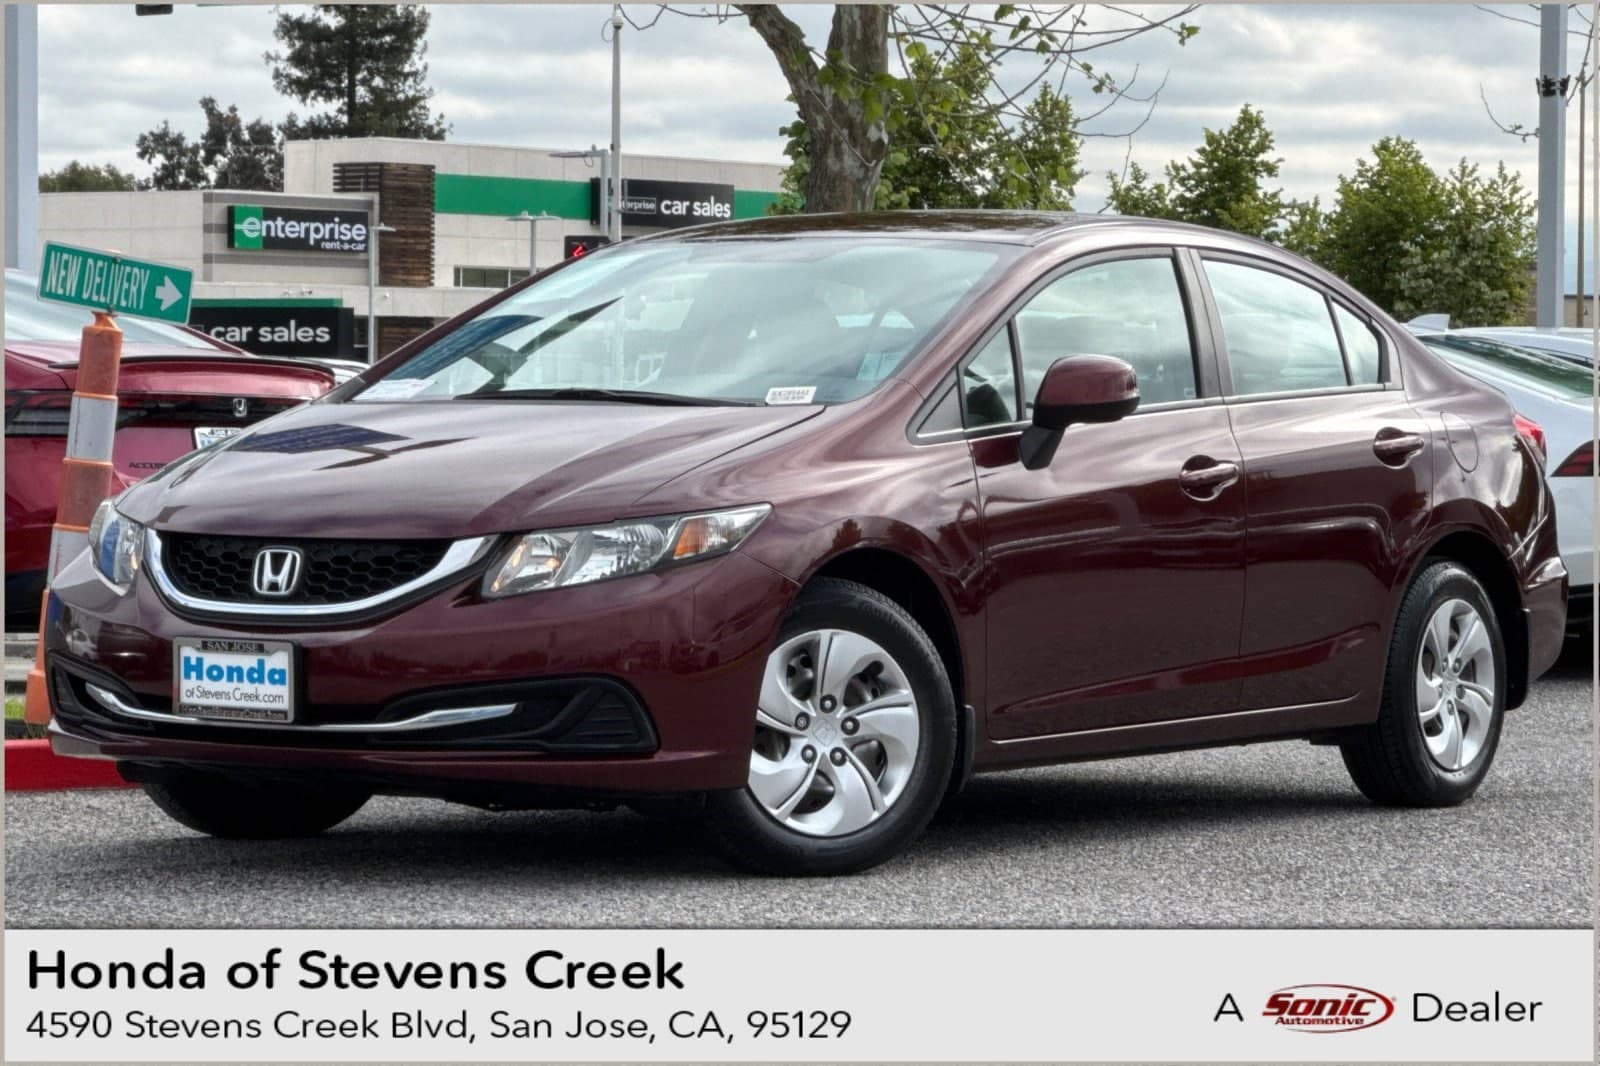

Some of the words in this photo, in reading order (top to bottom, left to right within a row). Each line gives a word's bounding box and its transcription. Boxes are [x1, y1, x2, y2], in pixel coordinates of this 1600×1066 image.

[619, 200, 656, 210] terprise
[660, 199, 690, 215] car
[692, 196, 731, 217] sales
[236, 216, 367, 246] enterprise
[321, 241, 367, 251] rent-a-car
[46, 251, 82, 297] NEW
[81, 257, 150, 310] DELIVERY
[210, 325, 253, 343] car
[258, 319, 331, 343] sales
[129, 462, 169, 470] ACCOR
[207, 640, 229, 651] SAN
[183, 656, 287, 686] Honda
[185, 687, 195, 698] of
[196, 685, 231, 701] Stevens
[232, 687, 285, 704] Creek.com
